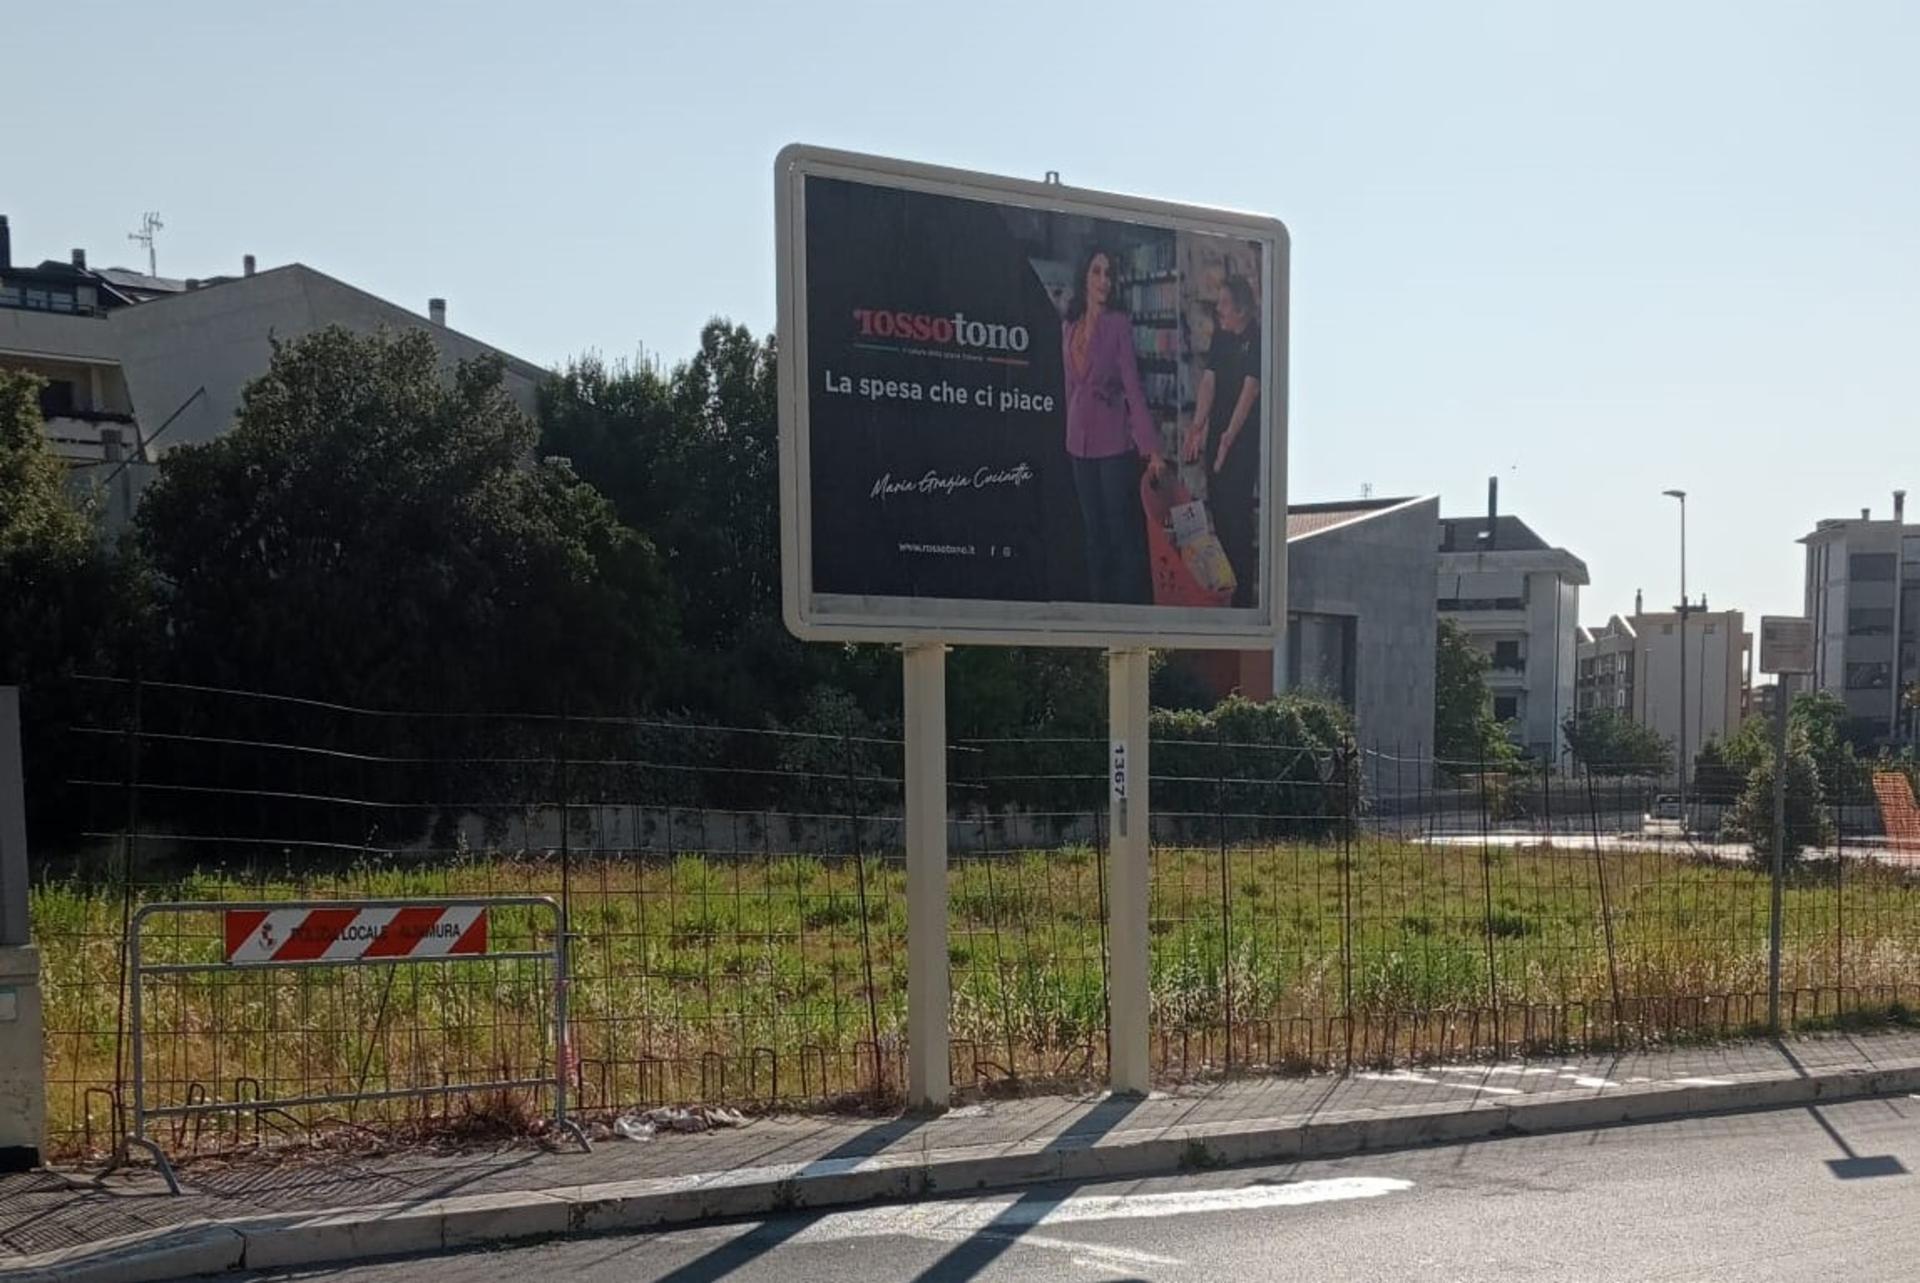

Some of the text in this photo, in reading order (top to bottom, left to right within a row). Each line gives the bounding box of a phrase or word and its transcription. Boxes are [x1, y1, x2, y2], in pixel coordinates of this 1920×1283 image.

[853, 309, 1029, 351] rossotono
[825, 370, 1054, 412] La spesa che ci piace
[871, 472, 916, 499] Maria
[918, 470, 971, 495] Grazia
[1114, 745, 1125, 796] 1367
[341, 924, 389, 942] LOCALE
[399, 922, 461, 940] ALMURA
